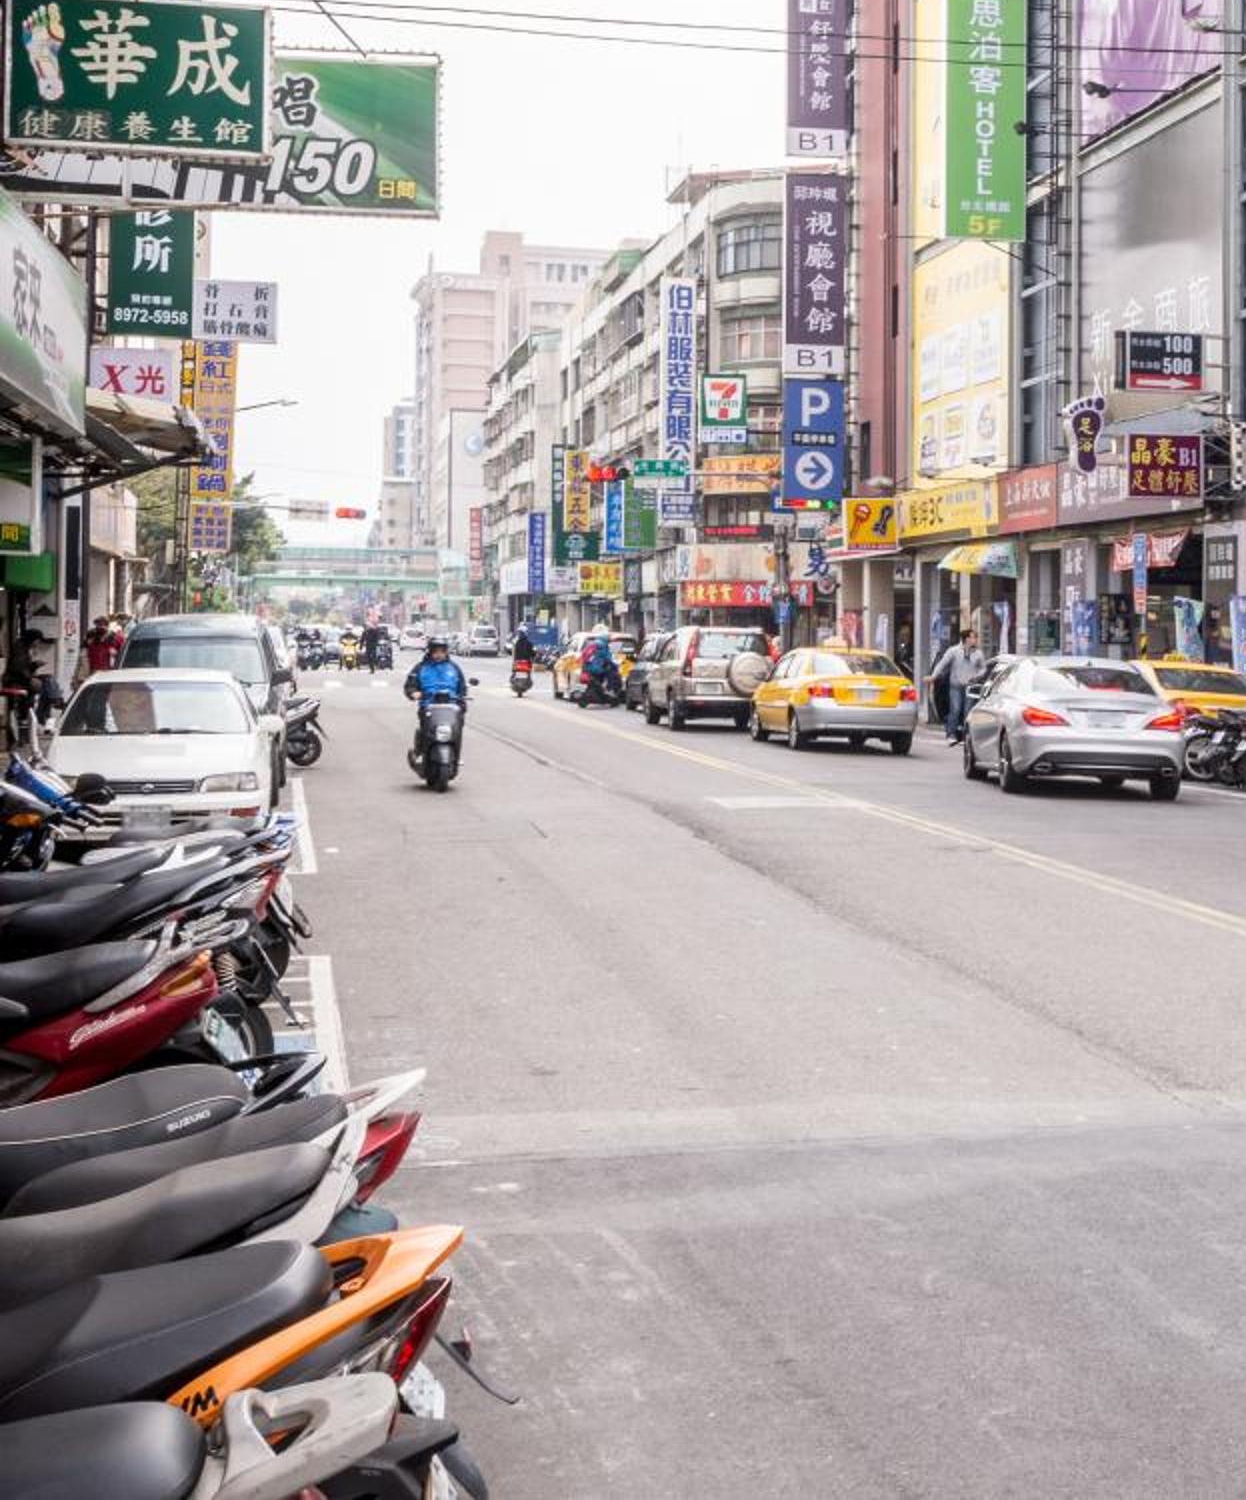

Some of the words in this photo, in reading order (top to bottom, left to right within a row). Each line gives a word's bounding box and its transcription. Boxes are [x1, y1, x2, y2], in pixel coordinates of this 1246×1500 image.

[70, 8, 250, 106] 華成
[968, 0, 1003, 95] 思泊客
[18, 110, 255, 145] 健康養生館
[800, 132, 836, 151] B1
[976, 103, 994, 195] HOTEL
[968, 217, 1001, 235] 5F
[113, 307, 189, 325] 8972-5958
[797, 350, 833, 368] B1
[1164, 335, 1193, 354] 100
[101, 364, 164, 395] X光
[1163, 357, 1193, 375] 500
[801, 387, 830, 426] P
[1131, 438, 1176, 466] 晶豪
[1179, 447, 1198, 467] B1
